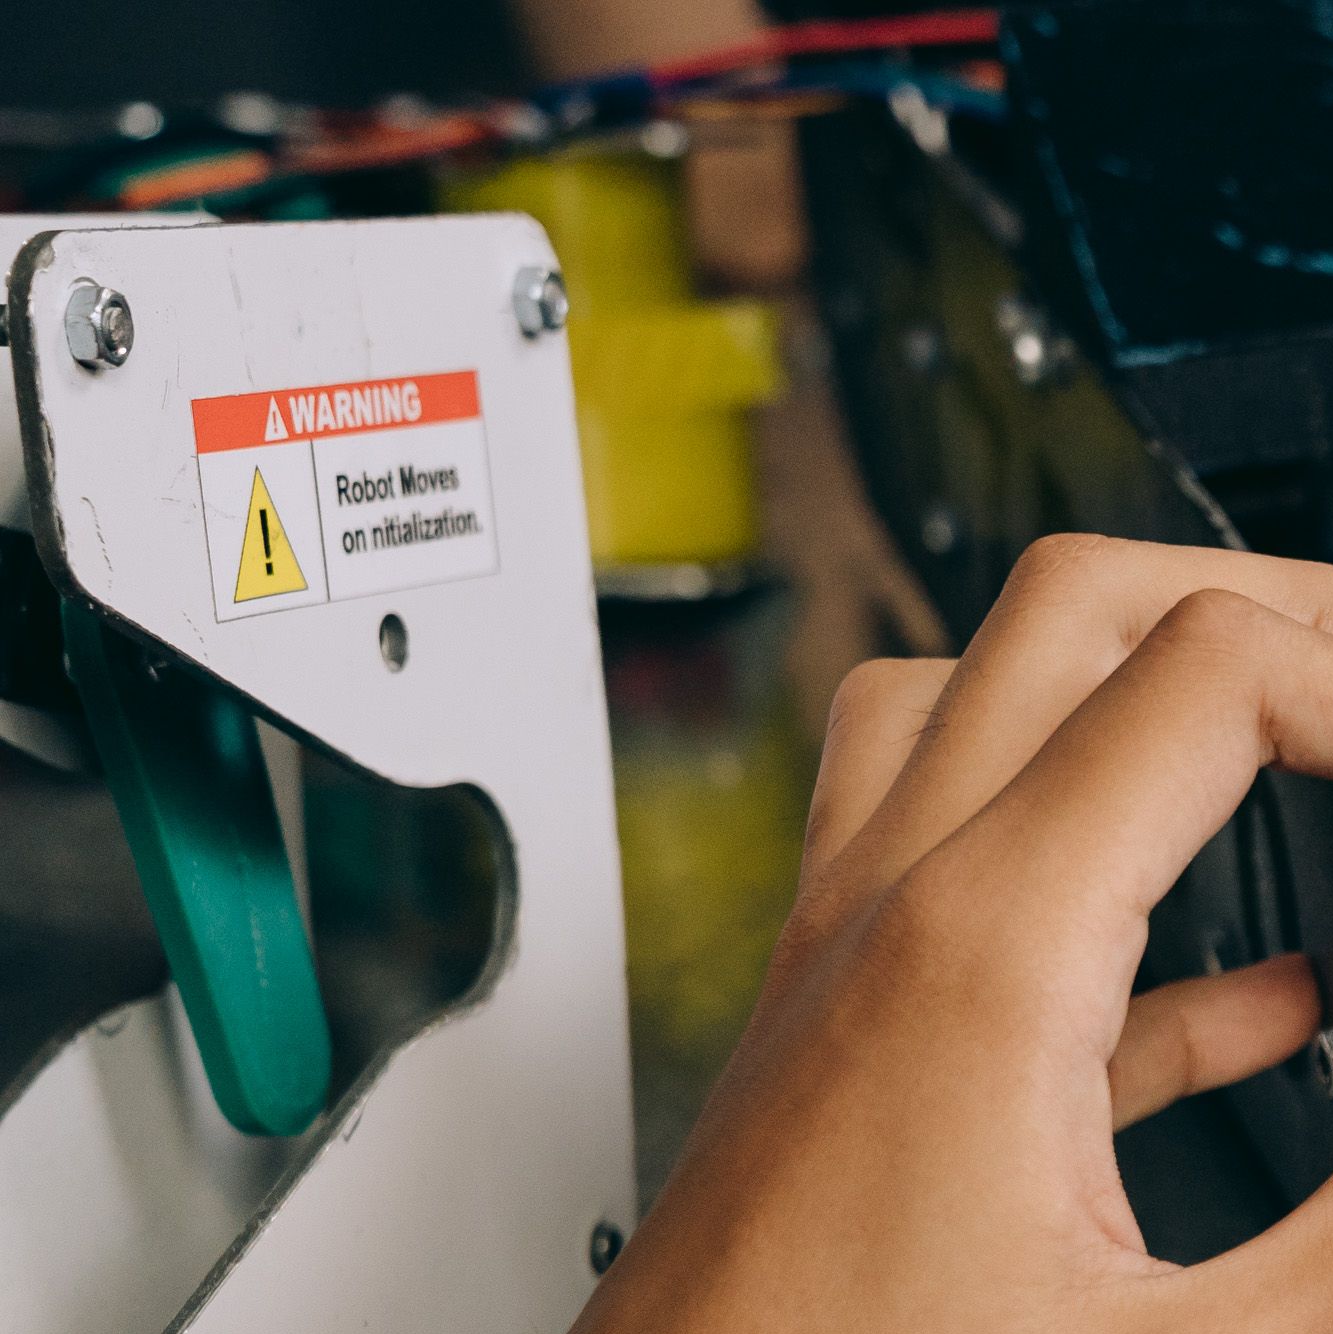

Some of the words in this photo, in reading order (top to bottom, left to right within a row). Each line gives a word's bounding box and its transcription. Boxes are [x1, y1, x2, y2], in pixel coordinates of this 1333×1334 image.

[288, 381, 422, 434] WARNING
[336, 471, 395, 506] Robot
[399, 464, 460, 496] Moves
[342, 528, 367, 555] on
